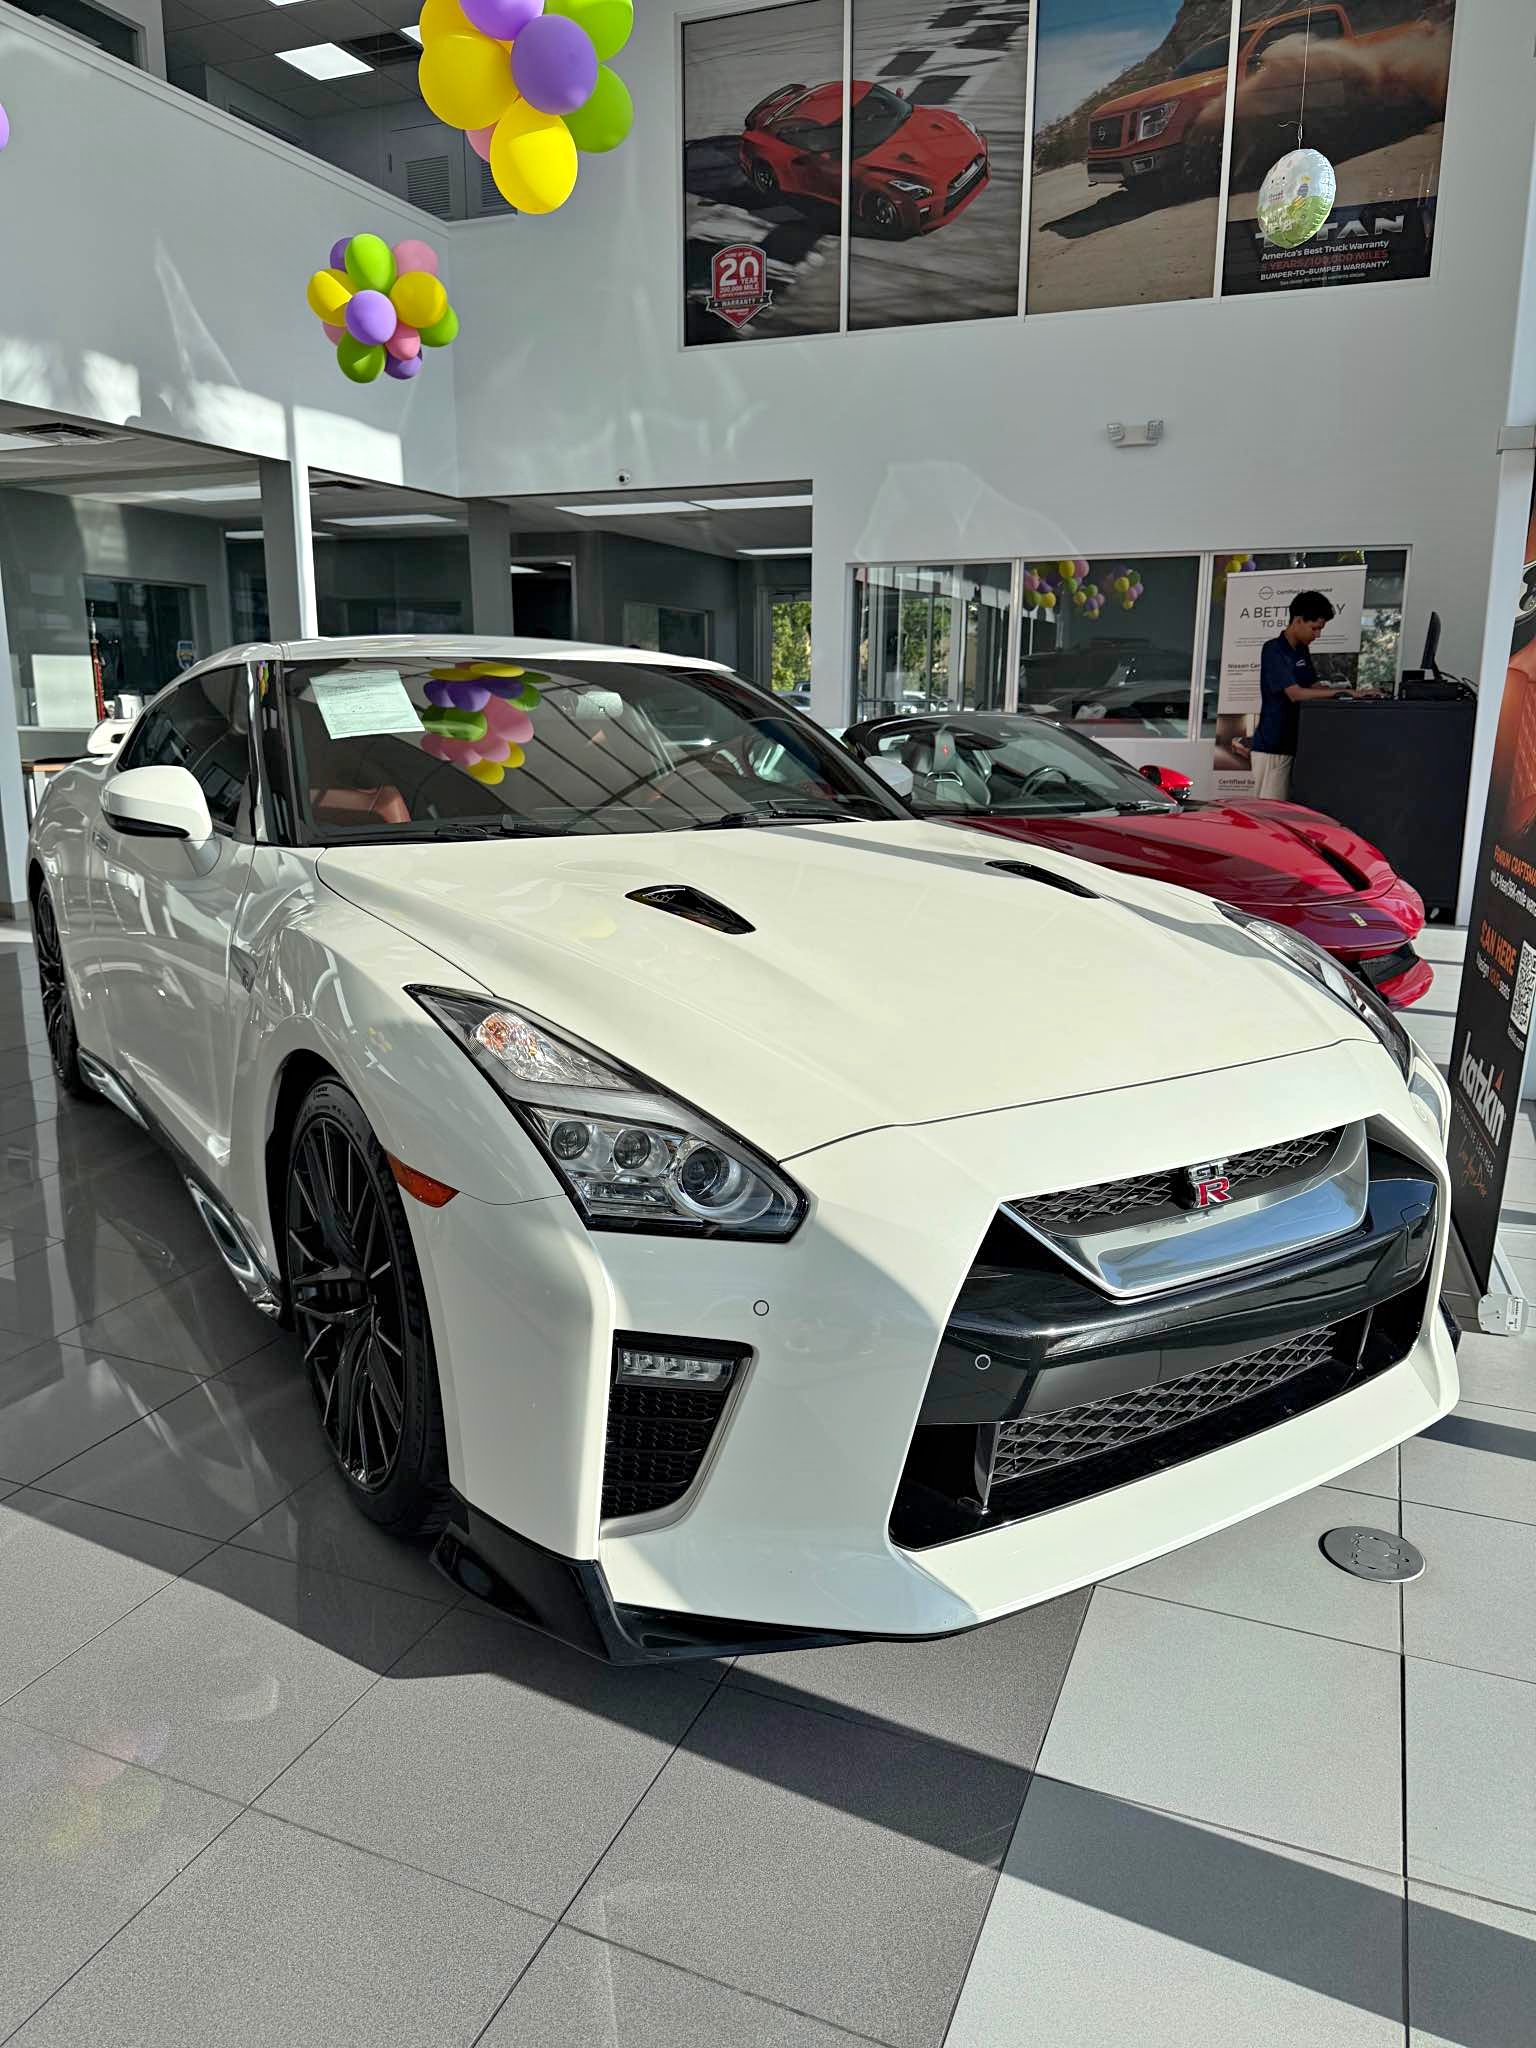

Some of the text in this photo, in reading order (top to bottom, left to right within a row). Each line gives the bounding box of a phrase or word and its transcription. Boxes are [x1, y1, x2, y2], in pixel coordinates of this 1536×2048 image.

[1262, 240, 1390, 260] America's Best Truck Warranty
[719, 255, 760, 287] 20
[1260, 265, 1341, 280] BUMPER-TO-BUMPER
[741, 277, 759, 285] YEAR
[721, 298, 756, 307] WARRANTY
[1240, 607, 1250, 619] A
[1262, 619, 1274, 628] TO
[1495, 935, 1518, 977] HERE
[1459, 1030, 1506, 1147] katzkin
